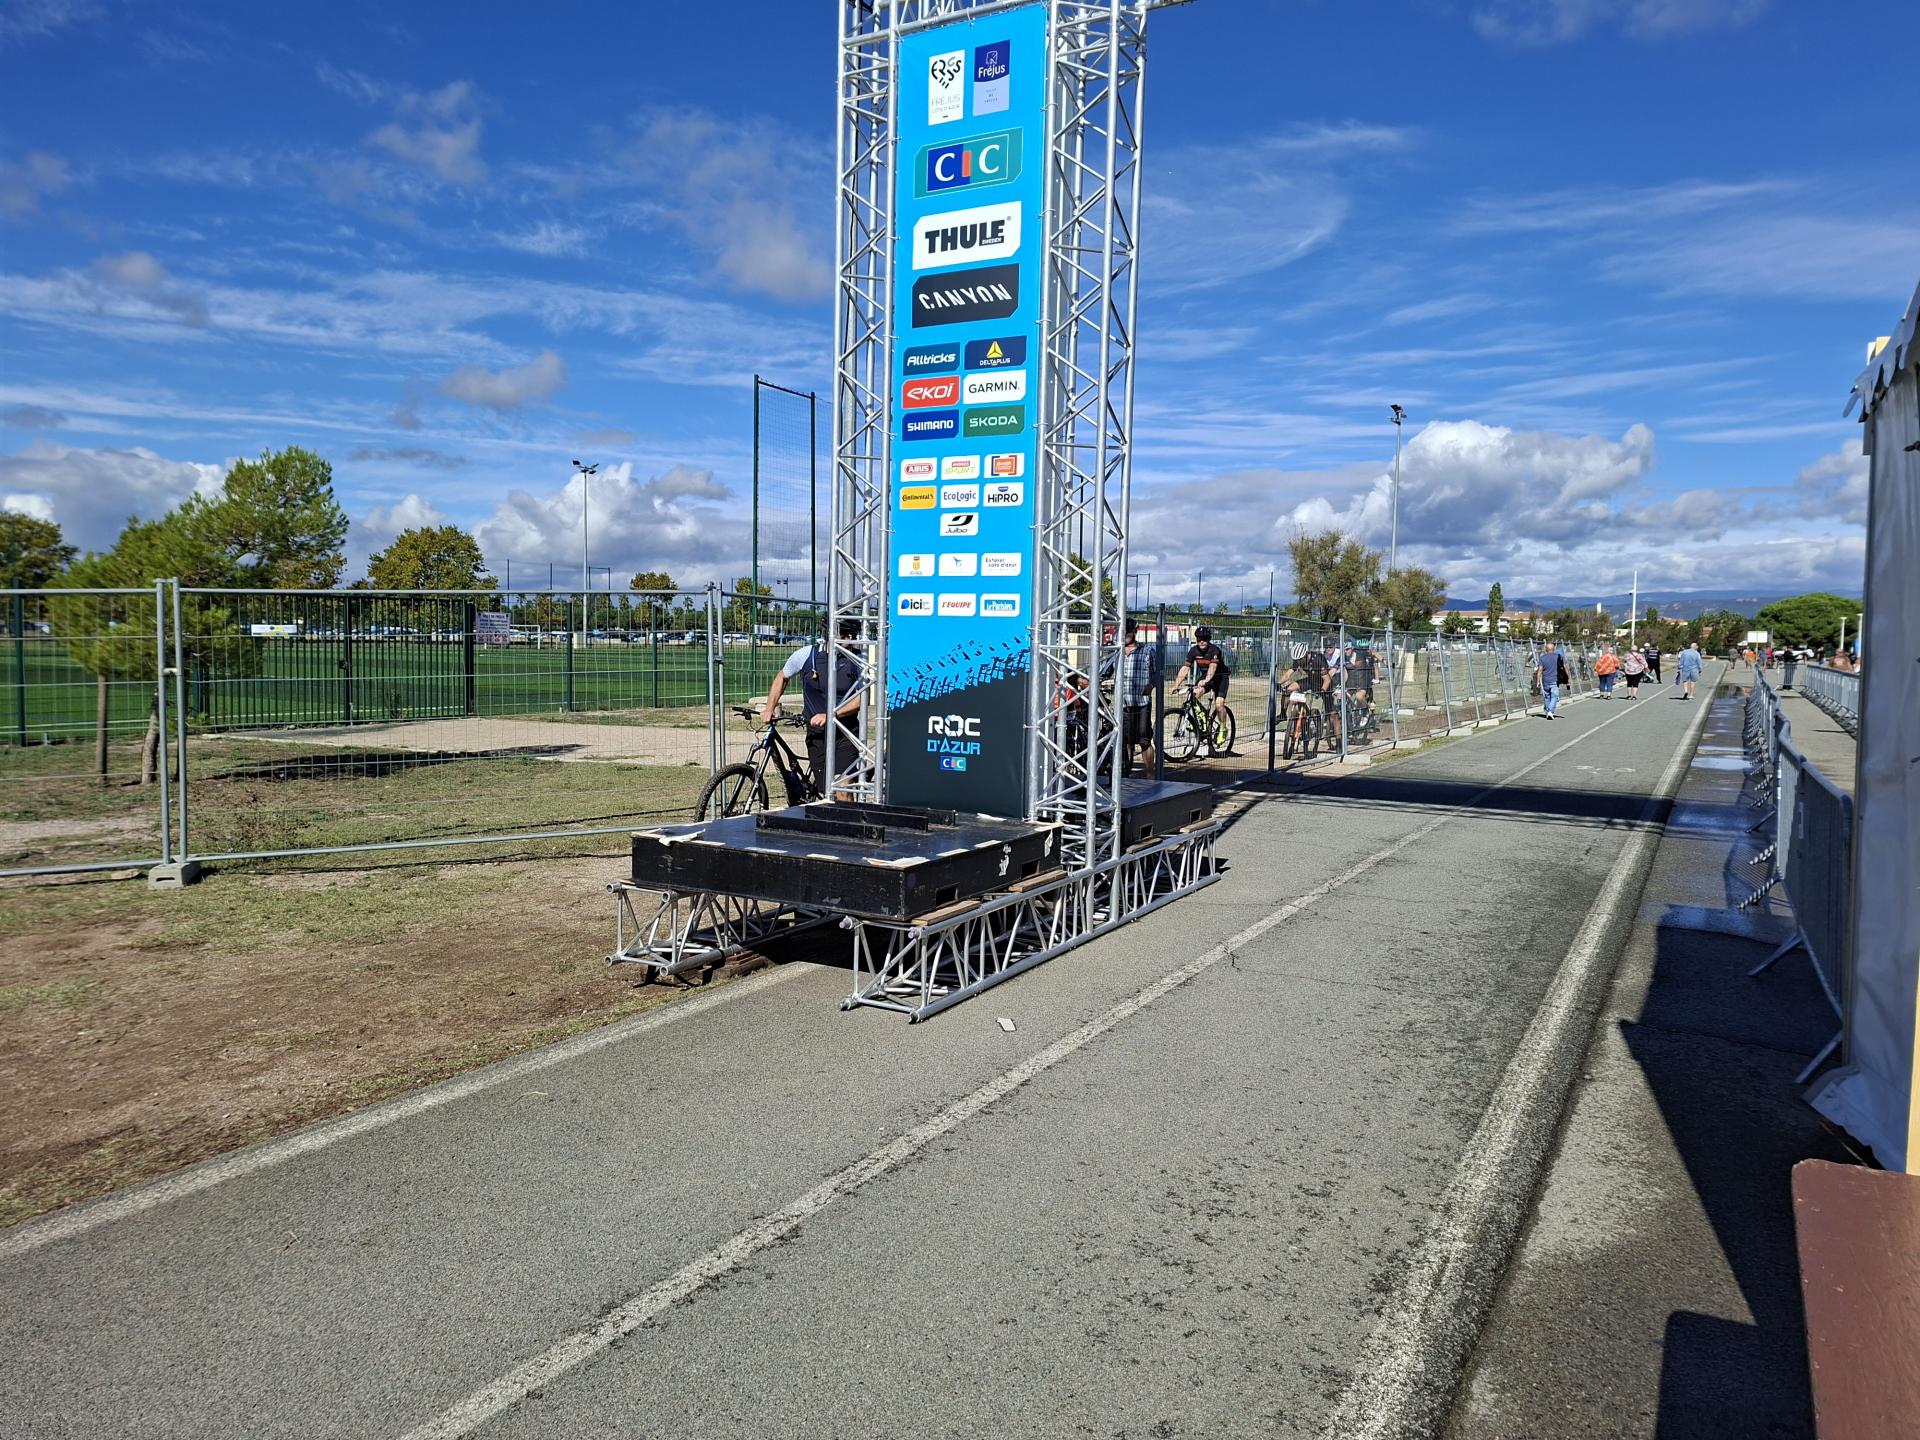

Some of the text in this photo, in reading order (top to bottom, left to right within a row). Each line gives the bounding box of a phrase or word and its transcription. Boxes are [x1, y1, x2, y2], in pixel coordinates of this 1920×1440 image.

[978, 65, 1005, 78] Fréjus
[935, 144, 1000, 182] CIC
[925, 219, 1005, 254] THULE
[918, 283, 1012, 309] CANYON
[907, 353, 956, 366] Alltricks
[968, 381, 1018, 393] GARMIN
[907, 420, 953, 432] SHIMANO
[910, 599, 923, 609] ici
[928, 714, 980, 737] ROC
[927, 737, 980, 755] D'AZUR
[943, 758, 963, 769] CIC
